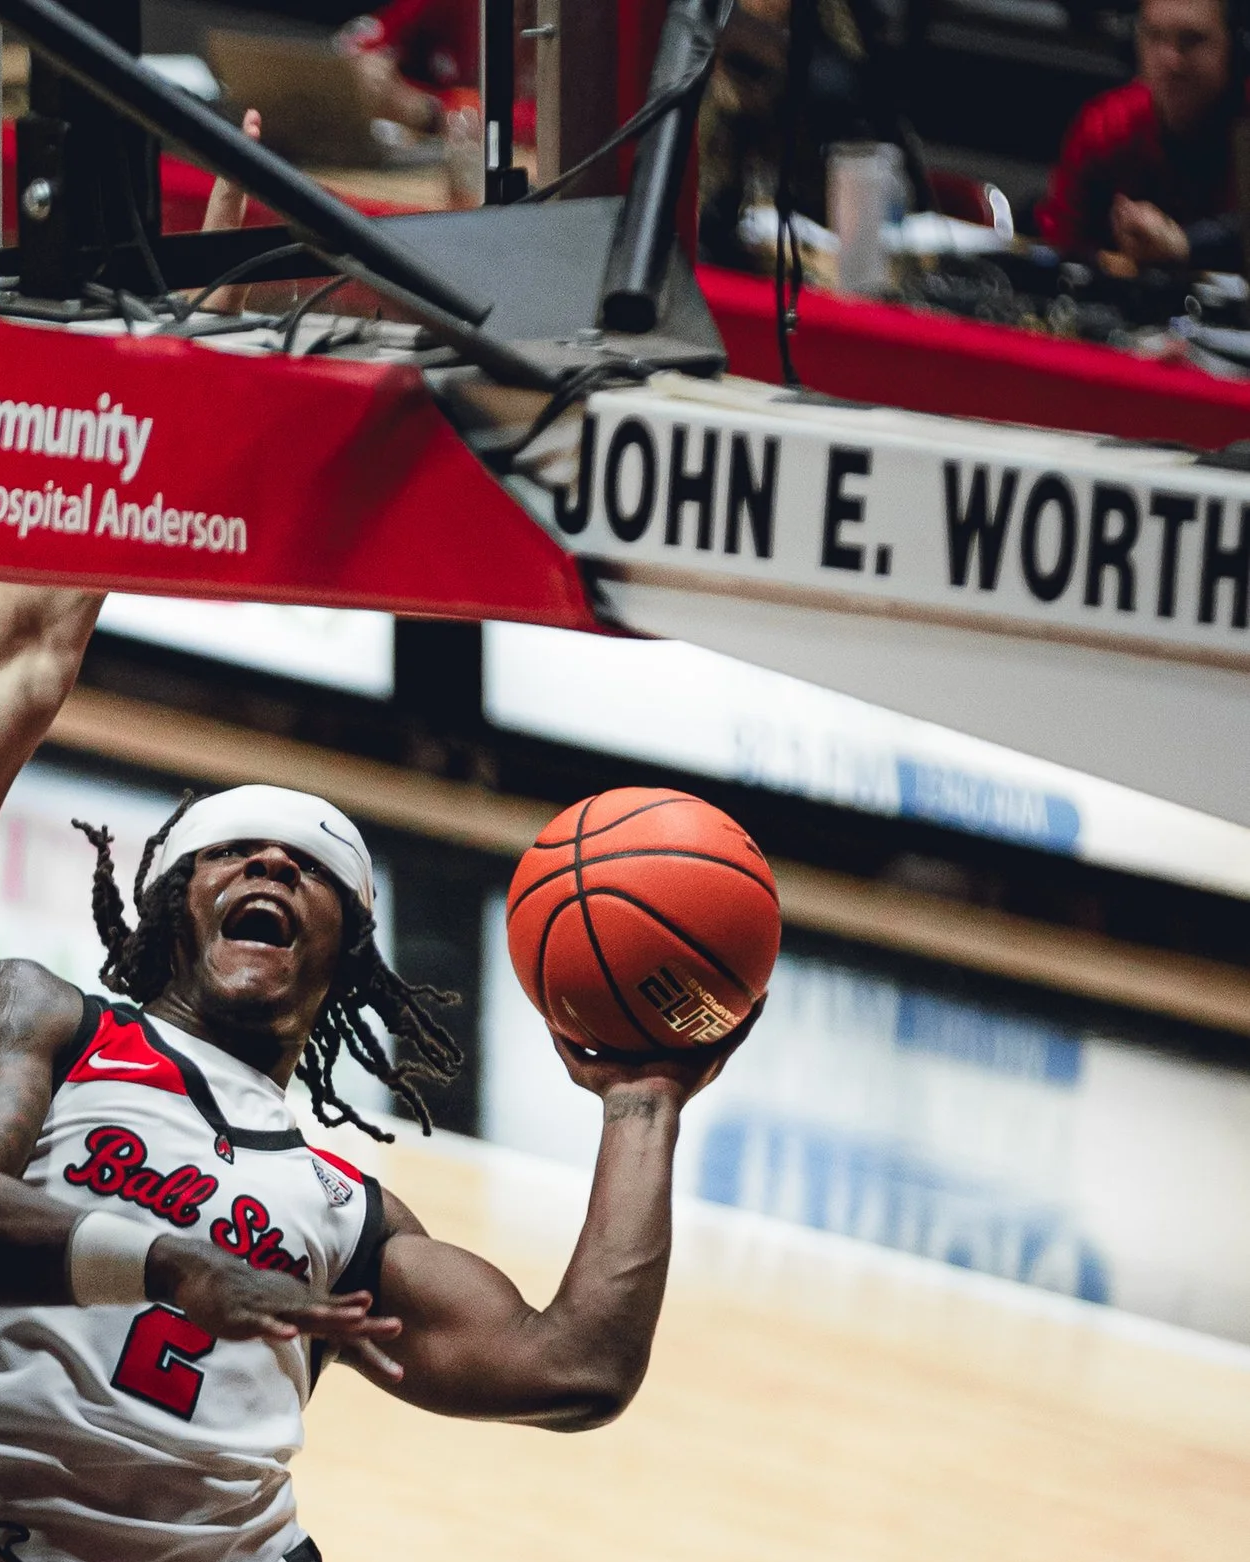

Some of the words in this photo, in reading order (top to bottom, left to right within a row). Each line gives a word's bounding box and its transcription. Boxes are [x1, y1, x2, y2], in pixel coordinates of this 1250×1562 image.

[96, 487, 248, 554] Anderson
[553, 412, 779, 559] JOHN
[821, 445, 892, 576] E.
[943, 459, 1250, 629] WORTH
[635, 964, 733, 1042] ELITE
[63, 1125, 220, 1228] Ball
